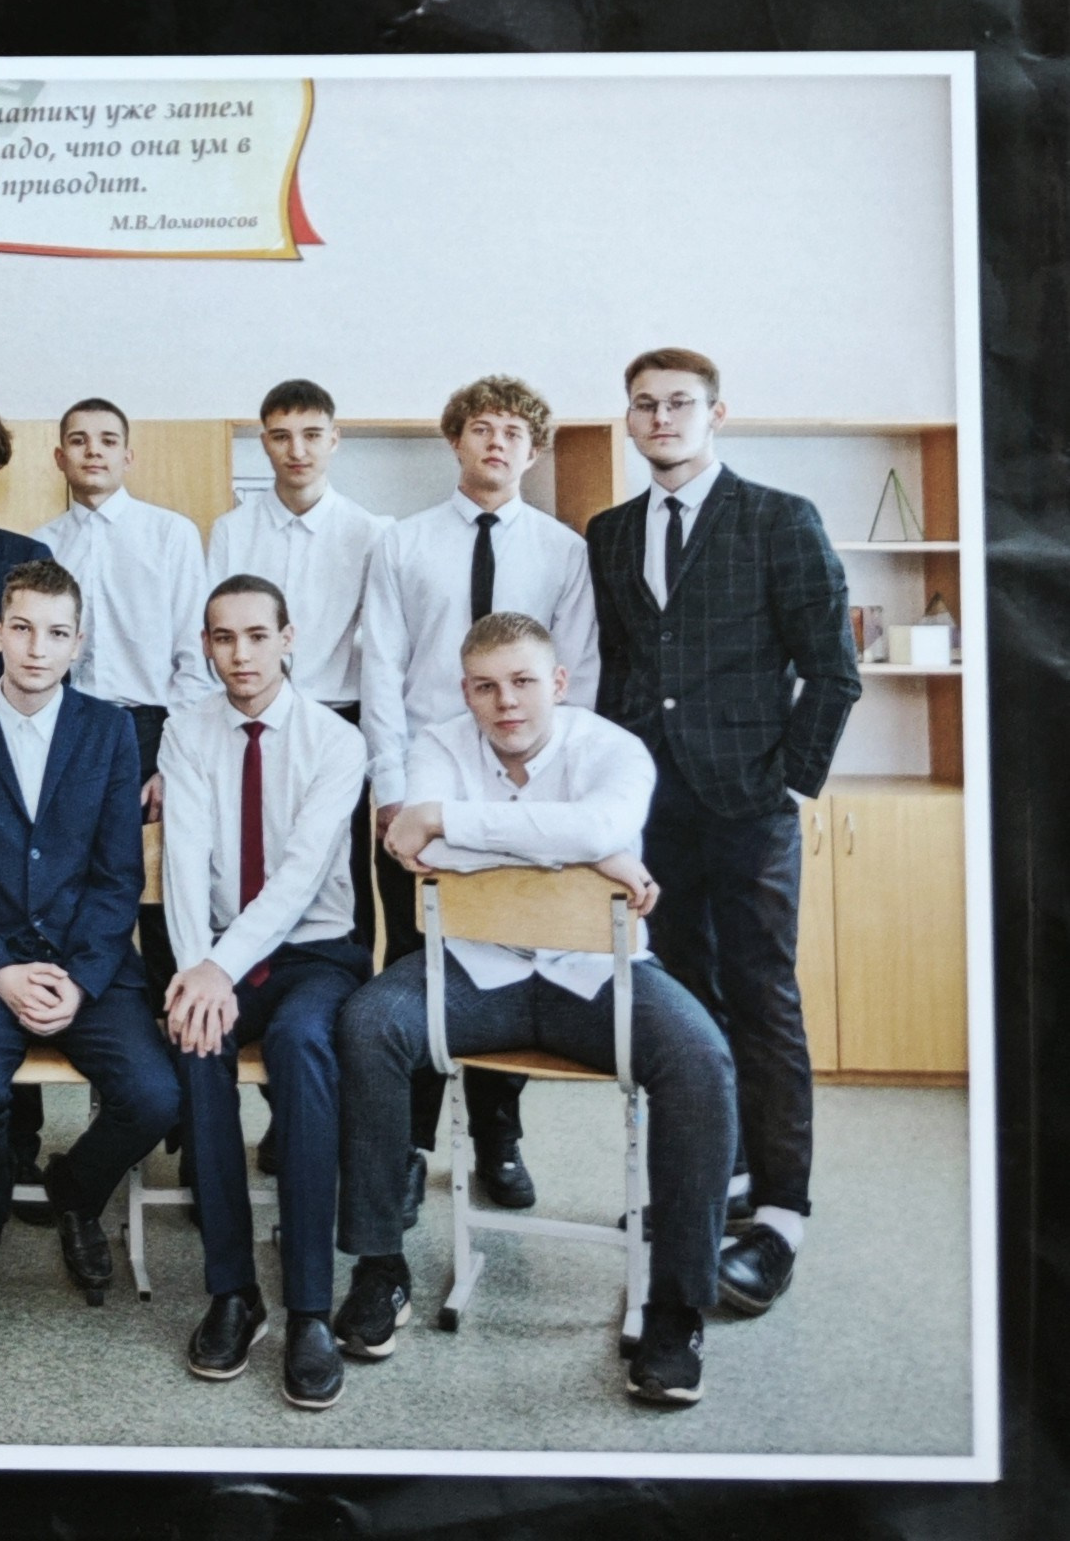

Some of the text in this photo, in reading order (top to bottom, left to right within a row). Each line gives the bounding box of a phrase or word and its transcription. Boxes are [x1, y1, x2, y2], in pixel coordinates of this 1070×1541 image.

[105, 103, 157, 128] уже
[164, 99, 254, 119] затем
[65, 139, 122, 158] что
[130, 138, 180, 157] она
[190, 136, 228, 163] ум
[236, 136, 252, 154] в
[1, 171, 148, 204] приводит.
